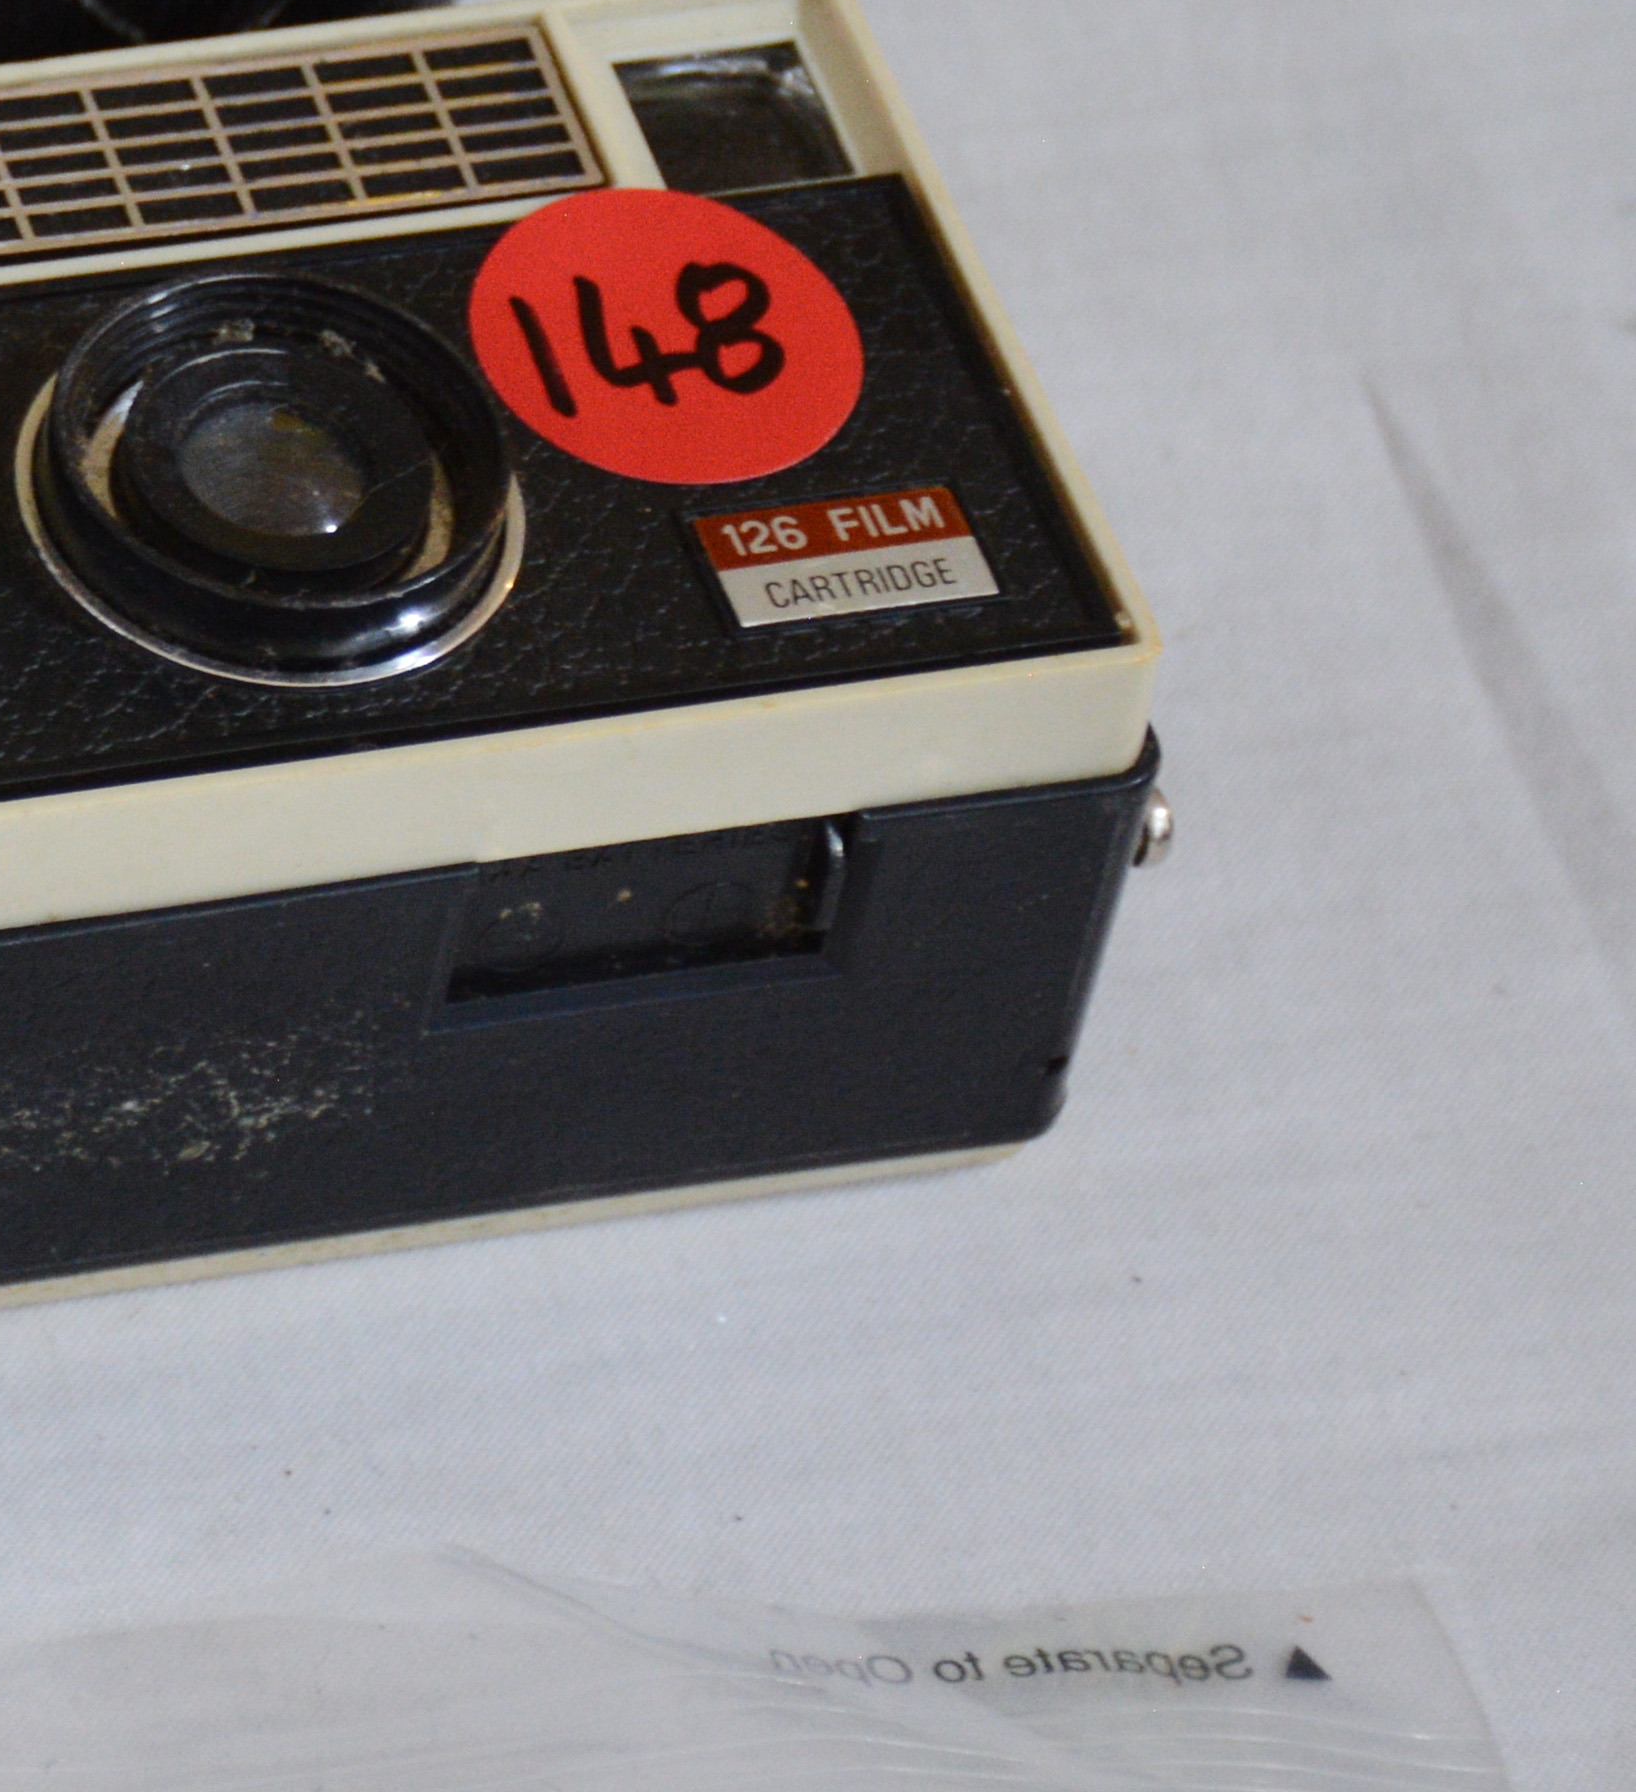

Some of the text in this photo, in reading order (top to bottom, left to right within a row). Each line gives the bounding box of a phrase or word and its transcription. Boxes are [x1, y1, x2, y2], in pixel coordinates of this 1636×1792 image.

[508, 261, 785, 418] 148
[722, 495, 946, 558] 126 FILM
[765, 557, 957, 609] CARTRIDGE
